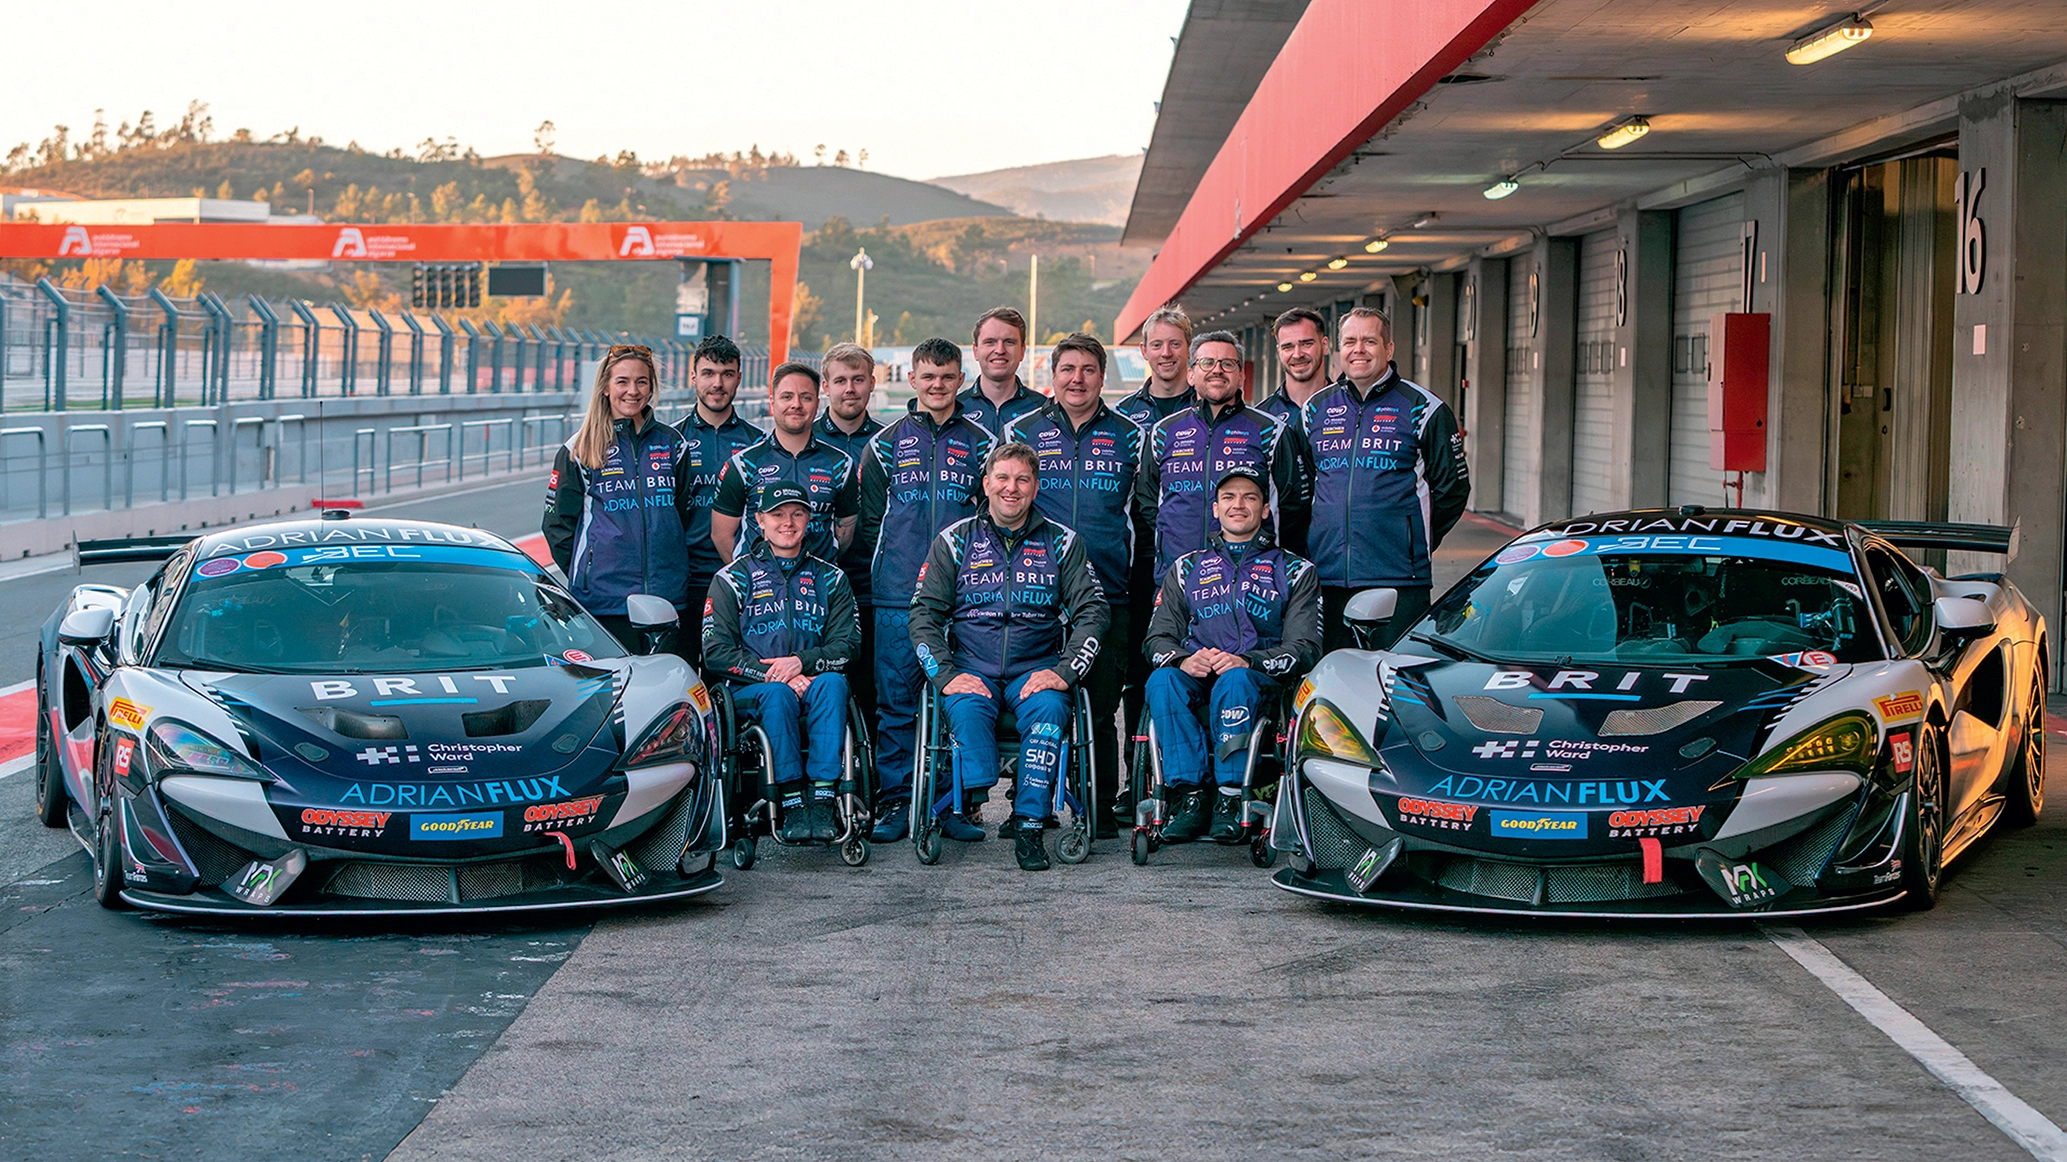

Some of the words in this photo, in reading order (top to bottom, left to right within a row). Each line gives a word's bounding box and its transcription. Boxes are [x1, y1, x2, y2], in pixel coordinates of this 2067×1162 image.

[1955, 167, 1986, 295] 16
[1614, 249, 1627, 326] 18
[1316, 438, 1352, 452] TEAM
[1362, 437, 1402, 451] BRIT
[1038, 459, 1072, 471] EAM
[1084, 459, 1123, 473] BRIT
[1166, 460, 1203, 474] TEAM
[1318, 456, 1398, 470] ADRIANFLUX
[596, 478, 636, 494] TEAM
[690, 473, 716, 485] AM
[892, 470, 930, 485] TEAM
[940, 469, 975, 486] BRIT
[1038, 477, 1121, 492] DRIANFLUX
[1168, 480, 1218, 493] ADRIAN
[603, 494, 675, 512] ADRIANFLU
[810, 500, 832, 512] RIT
[207, 526, 511, 557] ADRIANFLUX
[1510, 517, 1843, 548] ADRIANFLUX
[962, 571, 1004, 586] TEAM
[1016, 571, 1056, 586] BRIT
[964, 590, 1054, 606] ADRIANFLUX
[1192, 584, 1232, 601] TEAM
[1241, 580, 1280, 601] BRIT
[746, 600, 785, 617] TEAM
[746, 618, 824, 636] ADRIANFLX
[1070, 636, 1099, 676] SHD
[1809, 653, 1828, 665] E
[310, 675, 516, 700] BRIT
[1483, 671, 1709, 694] BRIT
[110, 700, 148, 725] PIRELLI
[1878, 693, 1924, 718] PIRELLI
[428, 742, 522, 754] Christopher
[429, 750, 474, 762] Ward
[1544, 749, 1592, 761] Ward
[1547, 739, 1649, 755] Christopher
[1896, 739, 1913, 765] RS
[116, 745, 131, 768] RS
[1025, 748, 1057, 766] SHD
[339, 775, 572, 806] ADRIANFLUX
[1427, 774, 1672, 804] ADRIANFLUX
[301, 808, 392, 828] ODYSSEY
[523, 796, 604, 822] ODYSSEY
[1397, 797, 1479, 823] ODYSSEY
[1607, 805, 1707, 829] ODYSSEY
[301, 824, 385, 838] BATTERY
[420, 818, 495, 833] GOODYEAR
[523, 815, 596, 832] BATTERY
[1399, 814, 1473, 832] BATTERY
[1500, 817, 1578, 832] GOODYEAR
[1608, 823, 1699, 838] BATTERY
[235, 885, 271, 904] WRAPS
[1731, 886, 1776, 905] WRAPS
